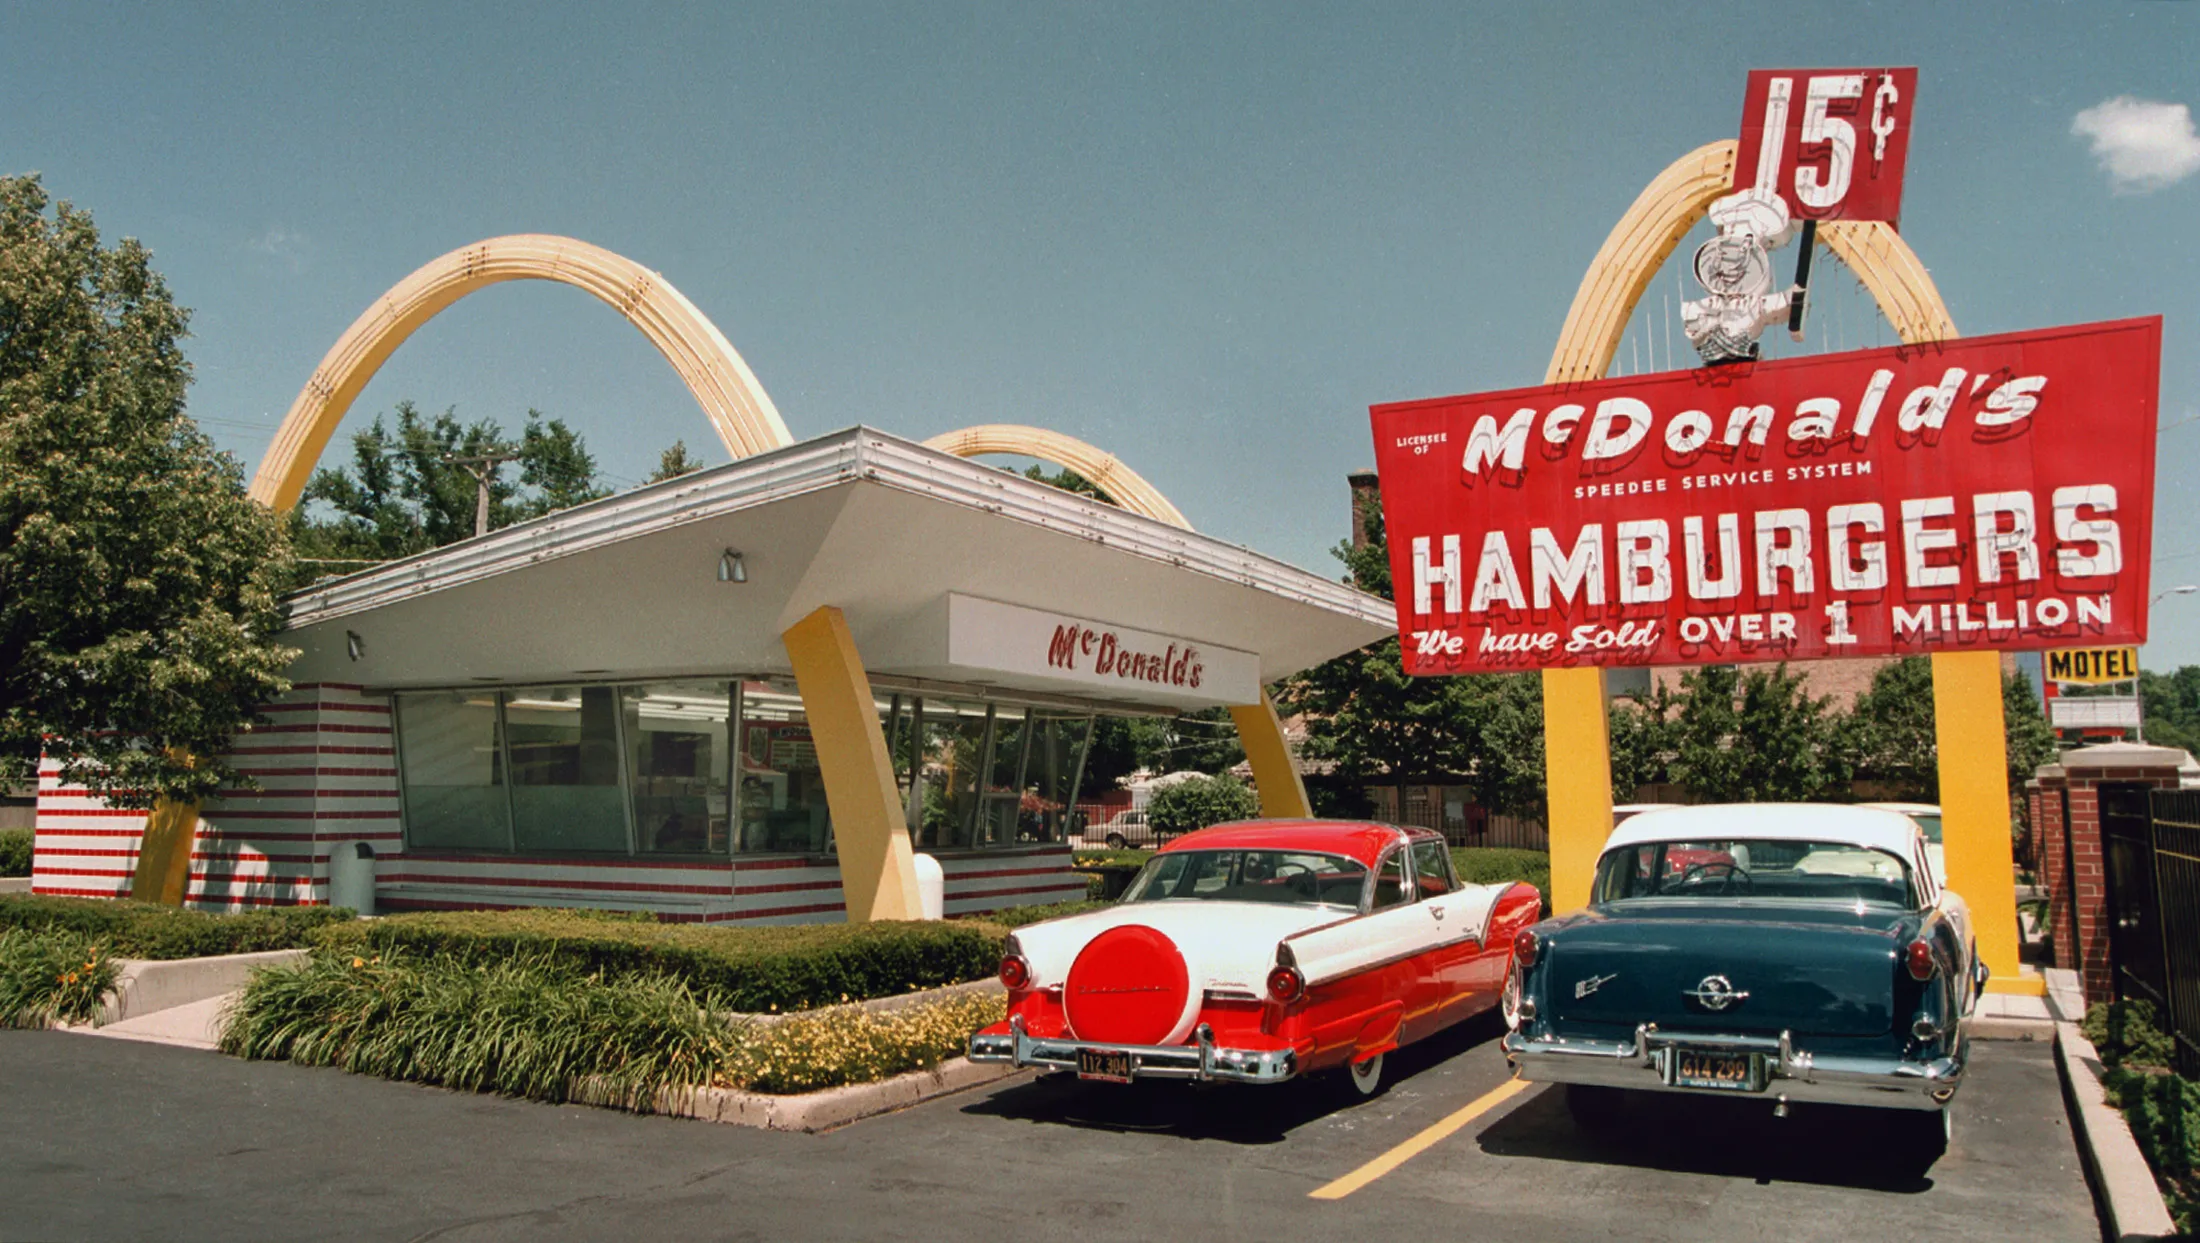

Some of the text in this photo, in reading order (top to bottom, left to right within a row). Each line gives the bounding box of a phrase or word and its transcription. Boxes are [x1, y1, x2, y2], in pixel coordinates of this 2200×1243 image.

[1461, 367, 2048, 475] McDonald's
[1396, 432, 1448, 447] LICENSEE
[1413, 444, 1429, 455] OF
[1574, 460, 1872, 499] SPEEDEE SERVICE SYSTEM
[1411, 483, 2123, 616] HAMBURGERS
[1411, 594, 2112, 656] We have Sold OVER 1 MILLION
[2049, 649, 2136, 679] MOTEL
[1682, 1056, 1746, 1081] 614 299
